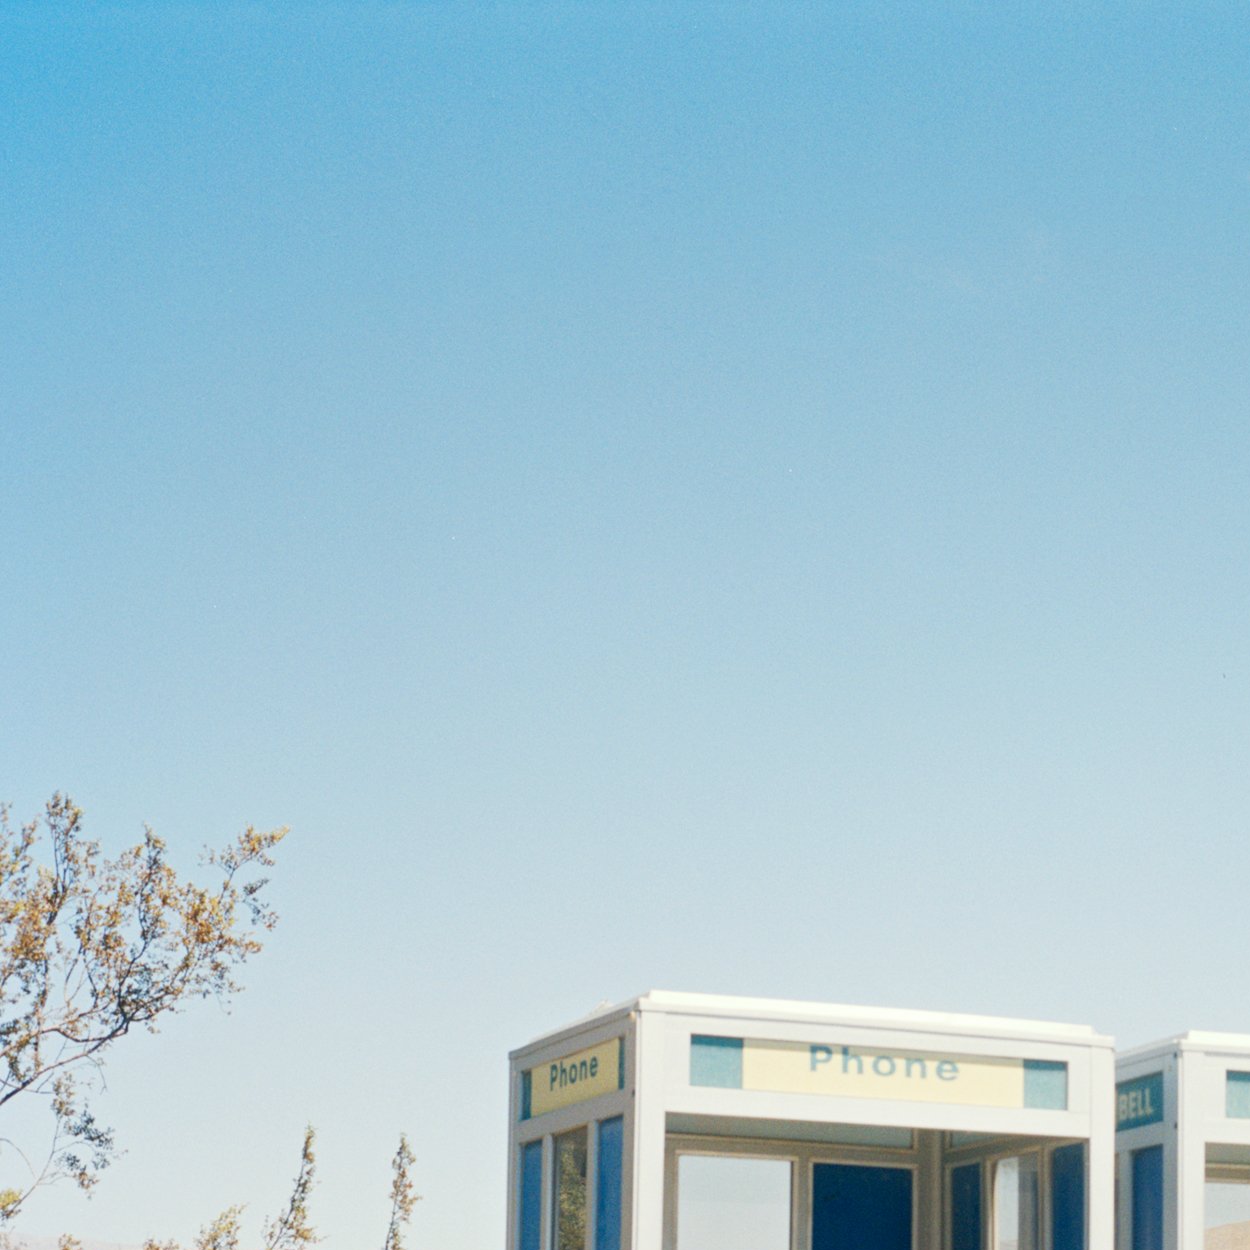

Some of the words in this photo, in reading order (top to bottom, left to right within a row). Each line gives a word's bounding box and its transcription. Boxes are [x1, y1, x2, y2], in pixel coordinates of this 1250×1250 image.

[549, 1055, 599, 1093] Phone
[809, 1044, 960, 1082] Phone
[1118, 1087, 1154, 1121] BELL
